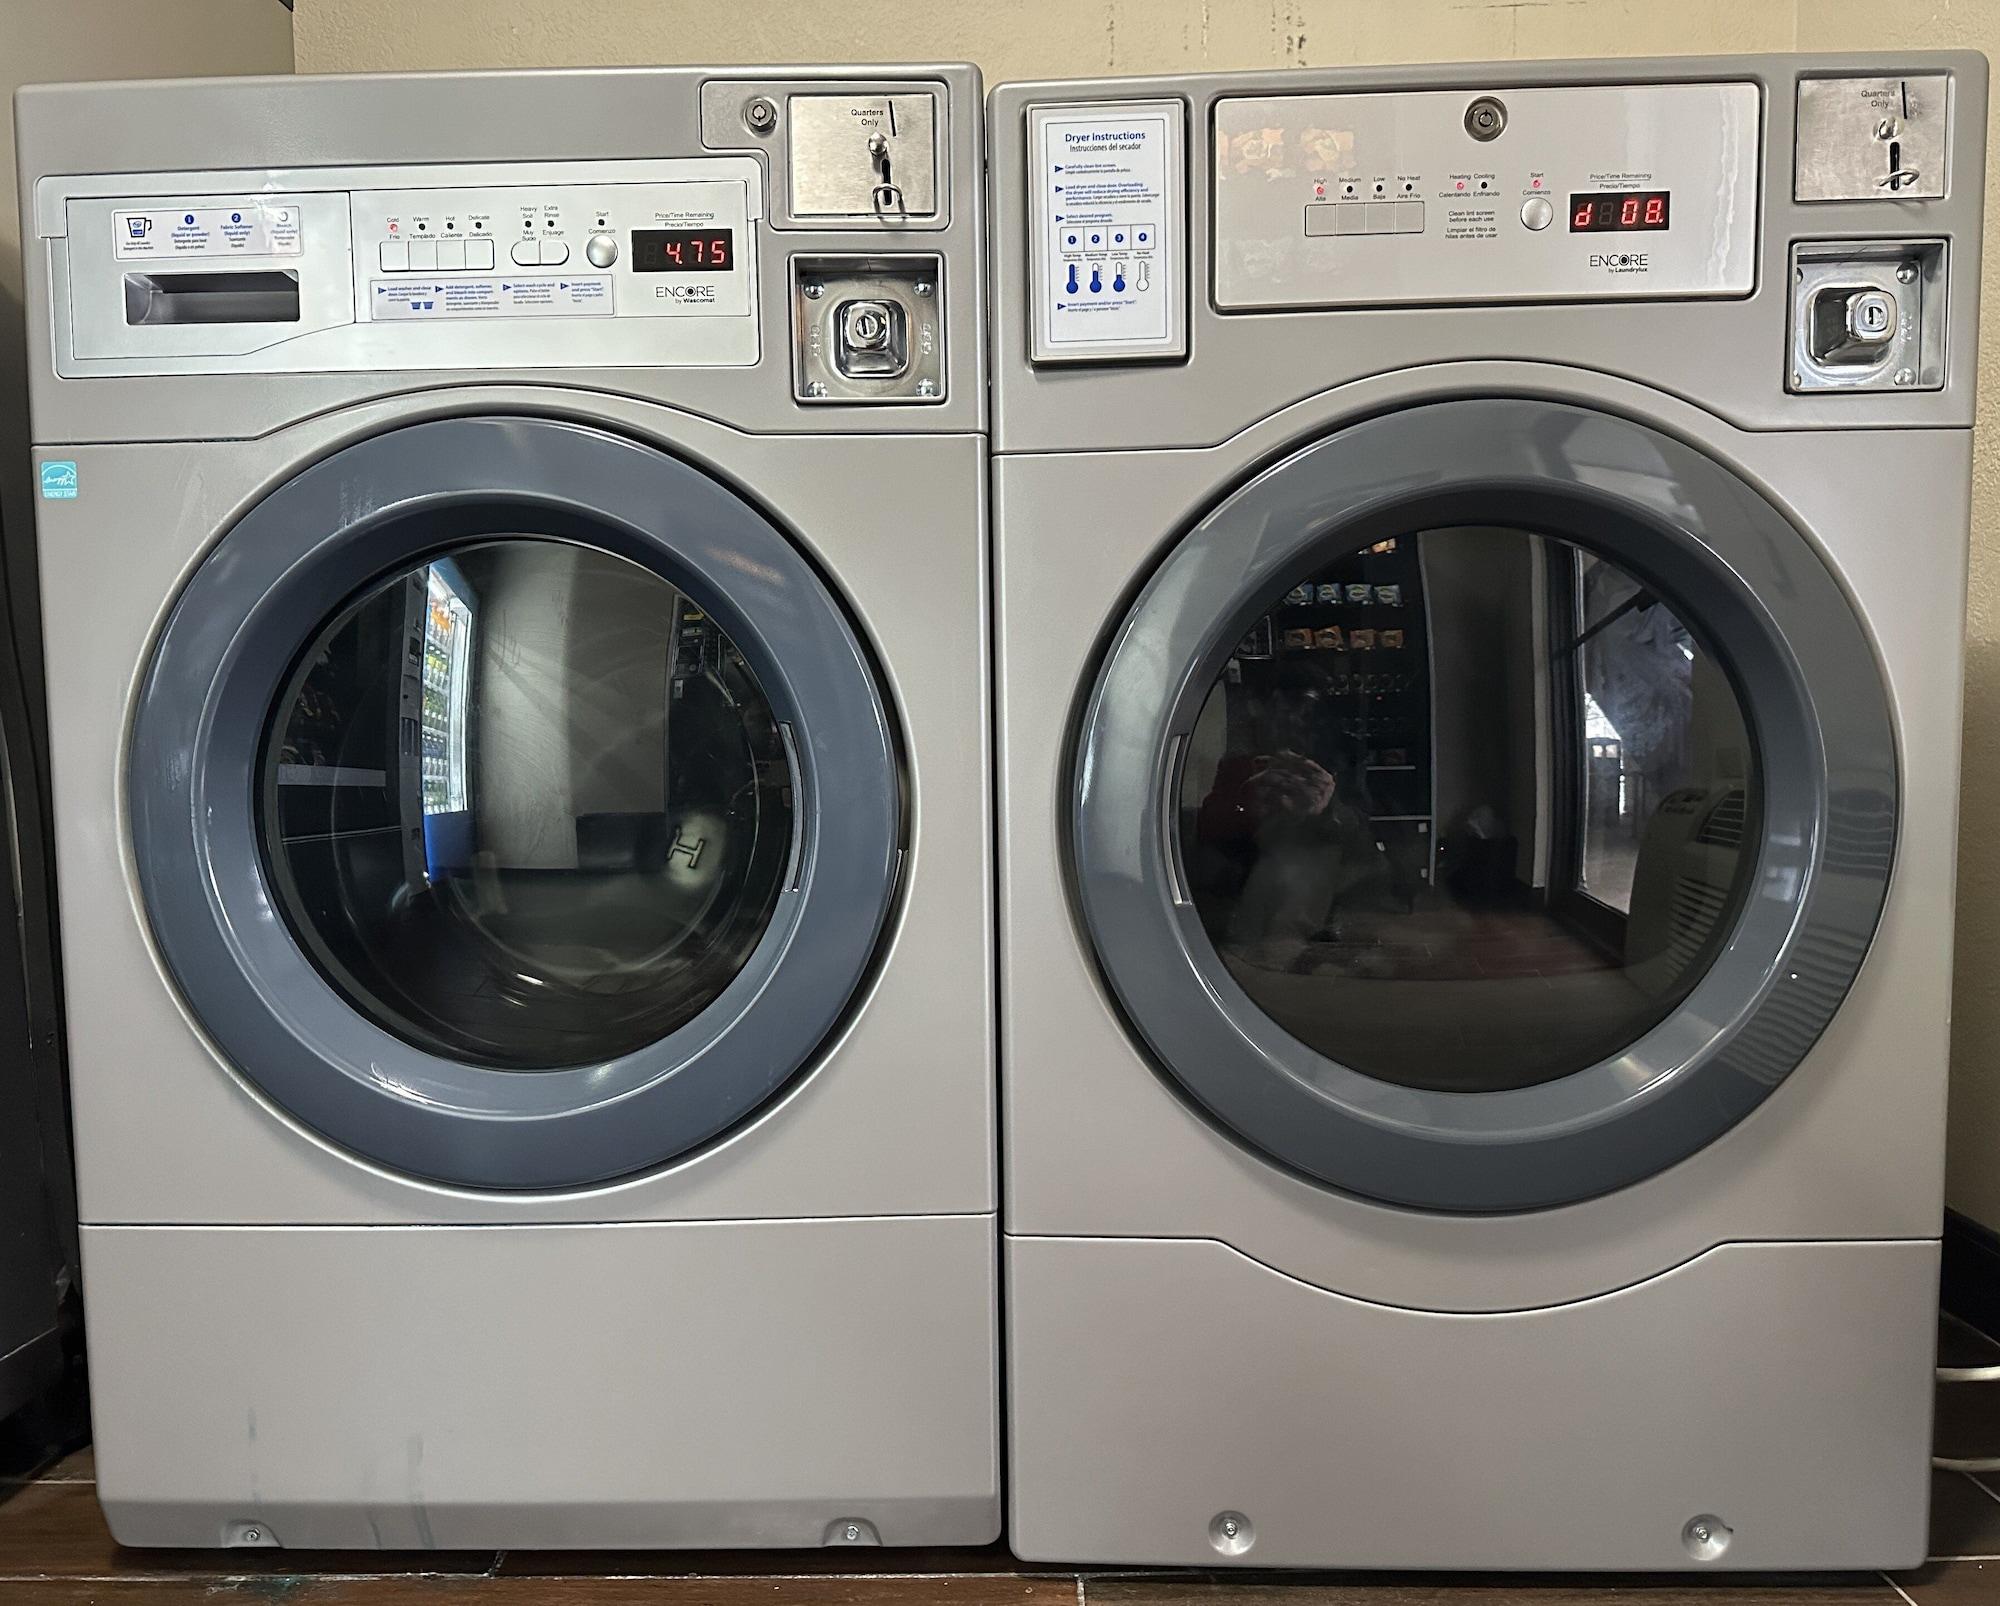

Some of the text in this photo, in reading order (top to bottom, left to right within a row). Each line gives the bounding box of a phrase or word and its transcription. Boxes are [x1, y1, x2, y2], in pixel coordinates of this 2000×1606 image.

[1871, 100, 1888, 109] Only
[851, 108, 884, 116] Quarters
[861, 119, 879, 127] Only
[1065, 131, 1146, 143] Dryer Instructions
[1070, 142, 1141, 152] Instrucciones del secador
[666, 240, 725, 264] 4.75
[1590, 254, 1648, 267] ENCORE
[656, 285, 715, 298] ENCORE
